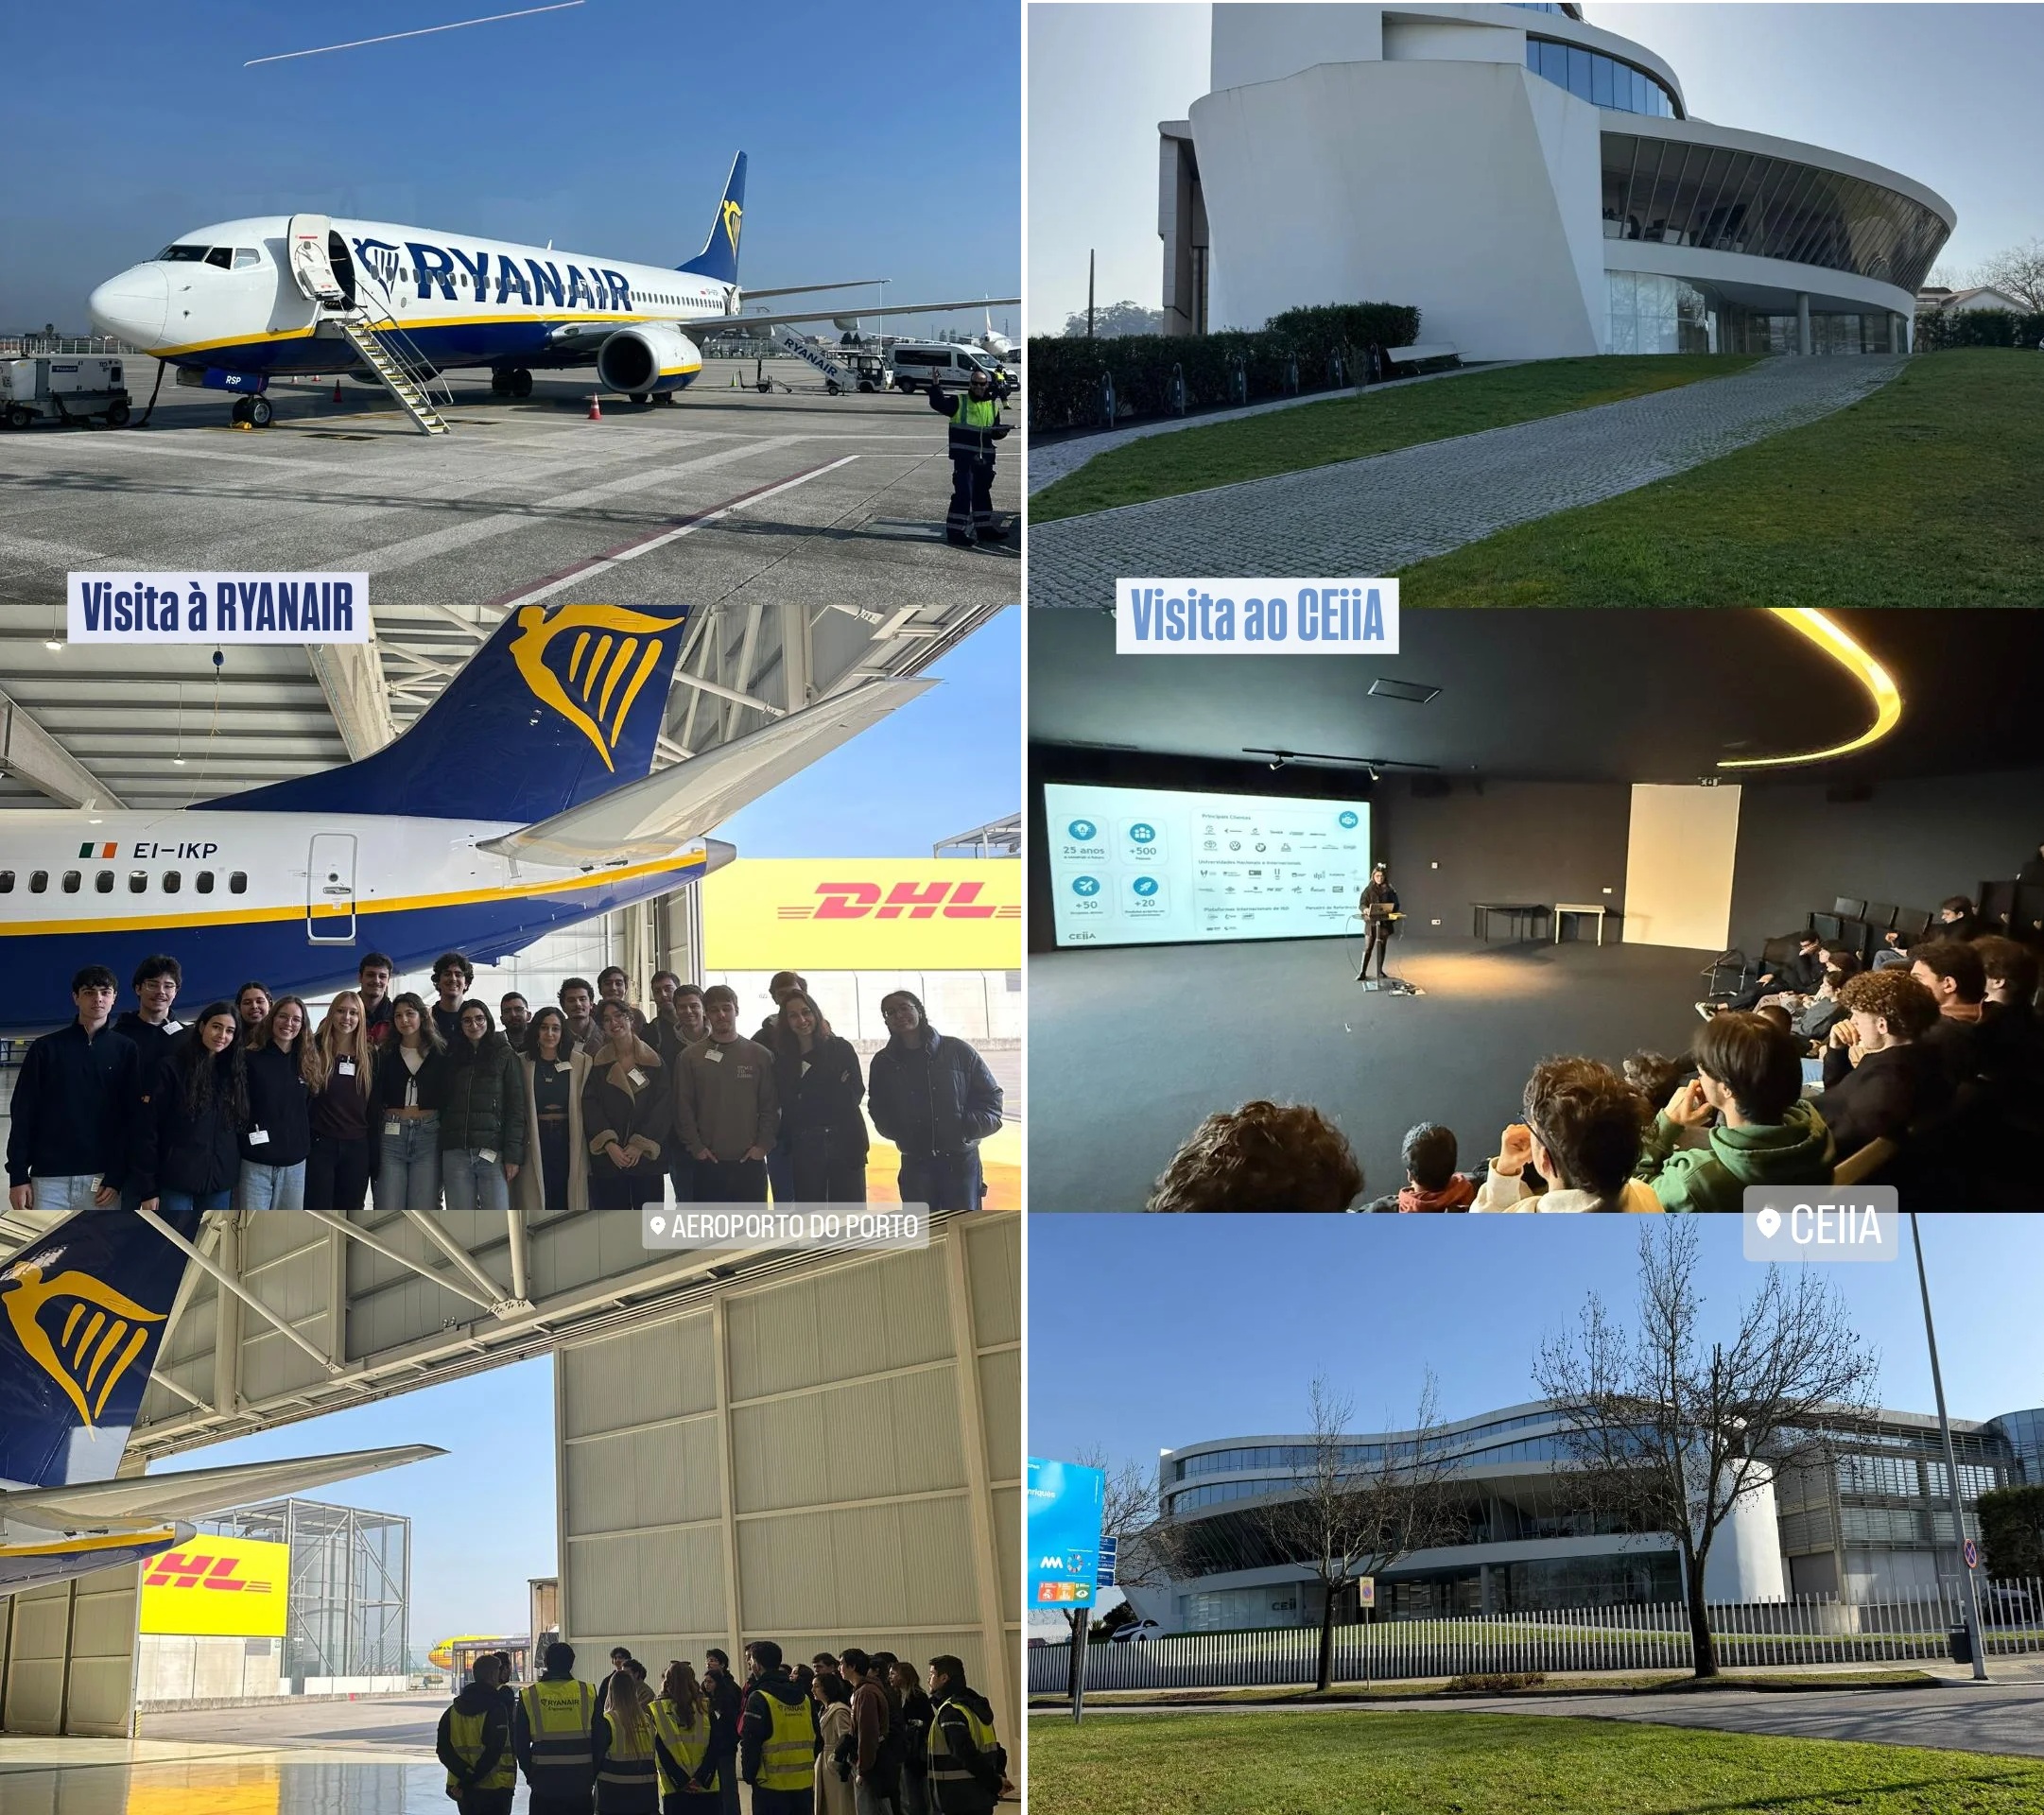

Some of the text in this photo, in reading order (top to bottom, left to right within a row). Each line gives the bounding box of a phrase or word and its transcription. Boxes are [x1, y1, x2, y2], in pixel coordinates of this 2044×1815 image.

[404, 241, 632, 312] RYANAIR
[784, 337, 838, 378] RYANAIR
[226, 375, 241, 385] RSP
[133, 842, 218, 859] EI-IKP
[1063, 846, 1077, 855] 25
[1130, 847, 1157, 856] +500
[812, 881, 997, 919] DHL
[1076, 901, 1098, 909] +50
[1135, 899, 1155, 908] +20
[143, 1552, 247, 1591] HL
